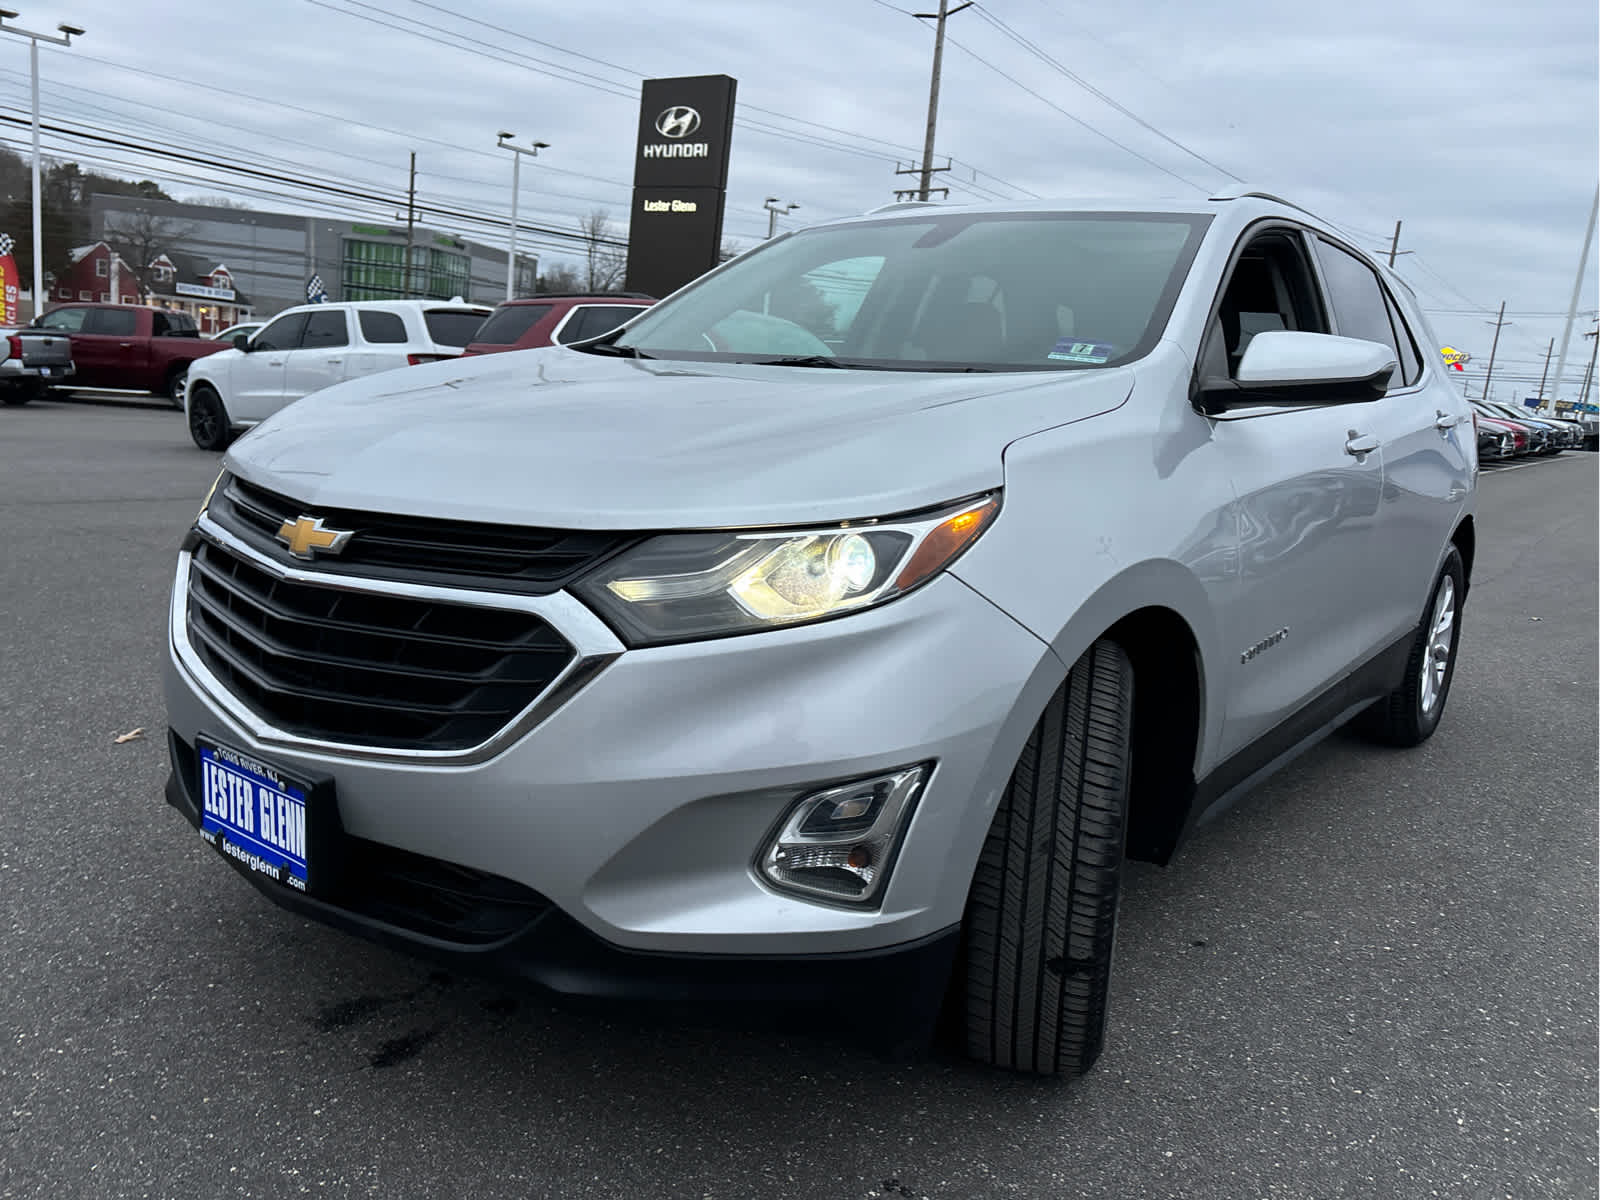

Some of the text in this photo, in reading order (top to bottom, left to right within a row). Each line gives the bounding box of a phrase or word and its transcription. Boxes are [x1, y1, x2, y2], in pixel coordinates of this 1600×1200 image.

[643, 143, 708, 158] HYUNDAI
[644, 199, 697, 212] Lester Glenn
[203, 761, 306, 860] LESTER GLENN
[222, 837, 280, 880] lesterglenn
